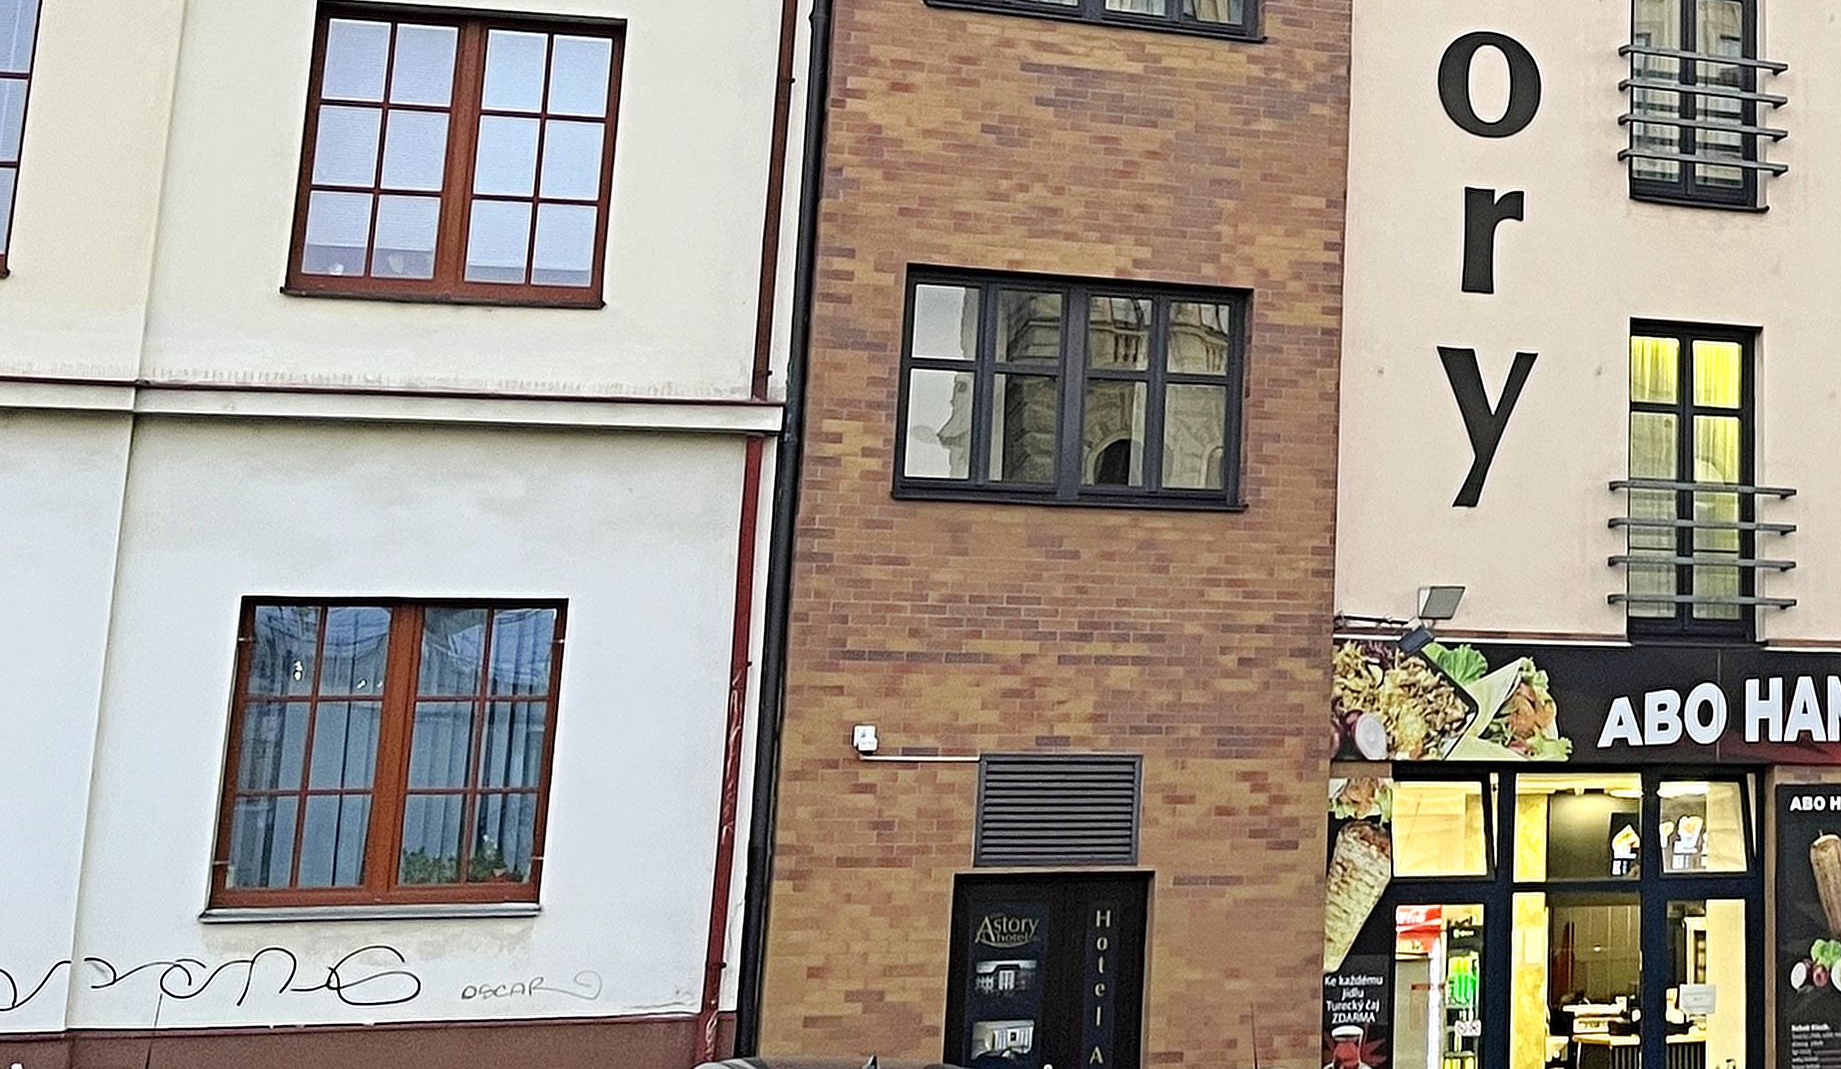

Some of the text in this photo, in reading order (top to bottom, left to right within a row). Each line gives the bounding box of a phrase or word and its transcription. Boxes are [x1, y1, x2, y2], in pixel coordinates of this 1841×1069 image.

[1596, 681, 1728, 749] ABO
[1789, 795, 1827, 812] ABO
[975, 916, 1040, 944] Astory
[1324, 975, 1337, 987] Ke
[1326, 999, 1364, 1013] Turecký
[1331, 1012, 1376, 1025] ZDARMA
